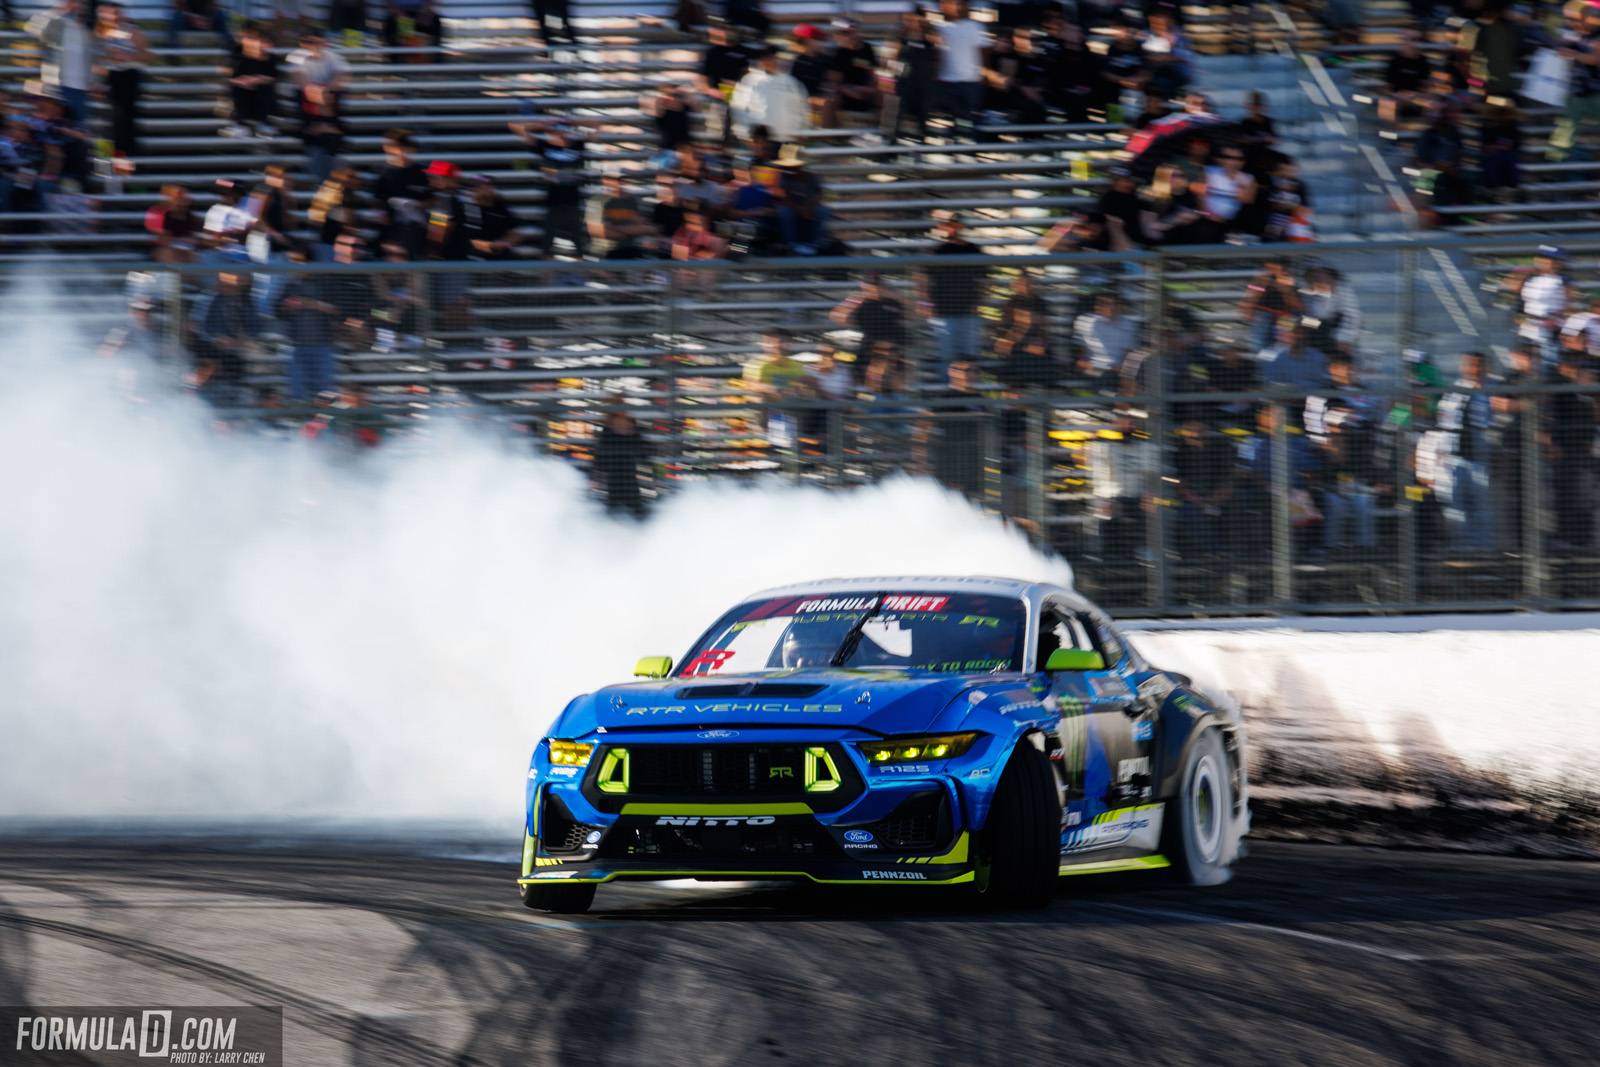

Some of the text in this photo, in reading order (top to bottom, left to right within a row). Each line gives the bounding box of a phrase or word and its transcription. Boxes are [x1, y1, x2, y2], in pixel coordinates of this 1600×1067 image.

[795, 596, 946, 613] FORMULA DRIFT
[626, 703, 843, 715] RTR VEHICLES
[969, 768, 991, 779] BC
[655, 816, 776, 826] NITTO
[862, 870, 928, 880] PENNZOIL
